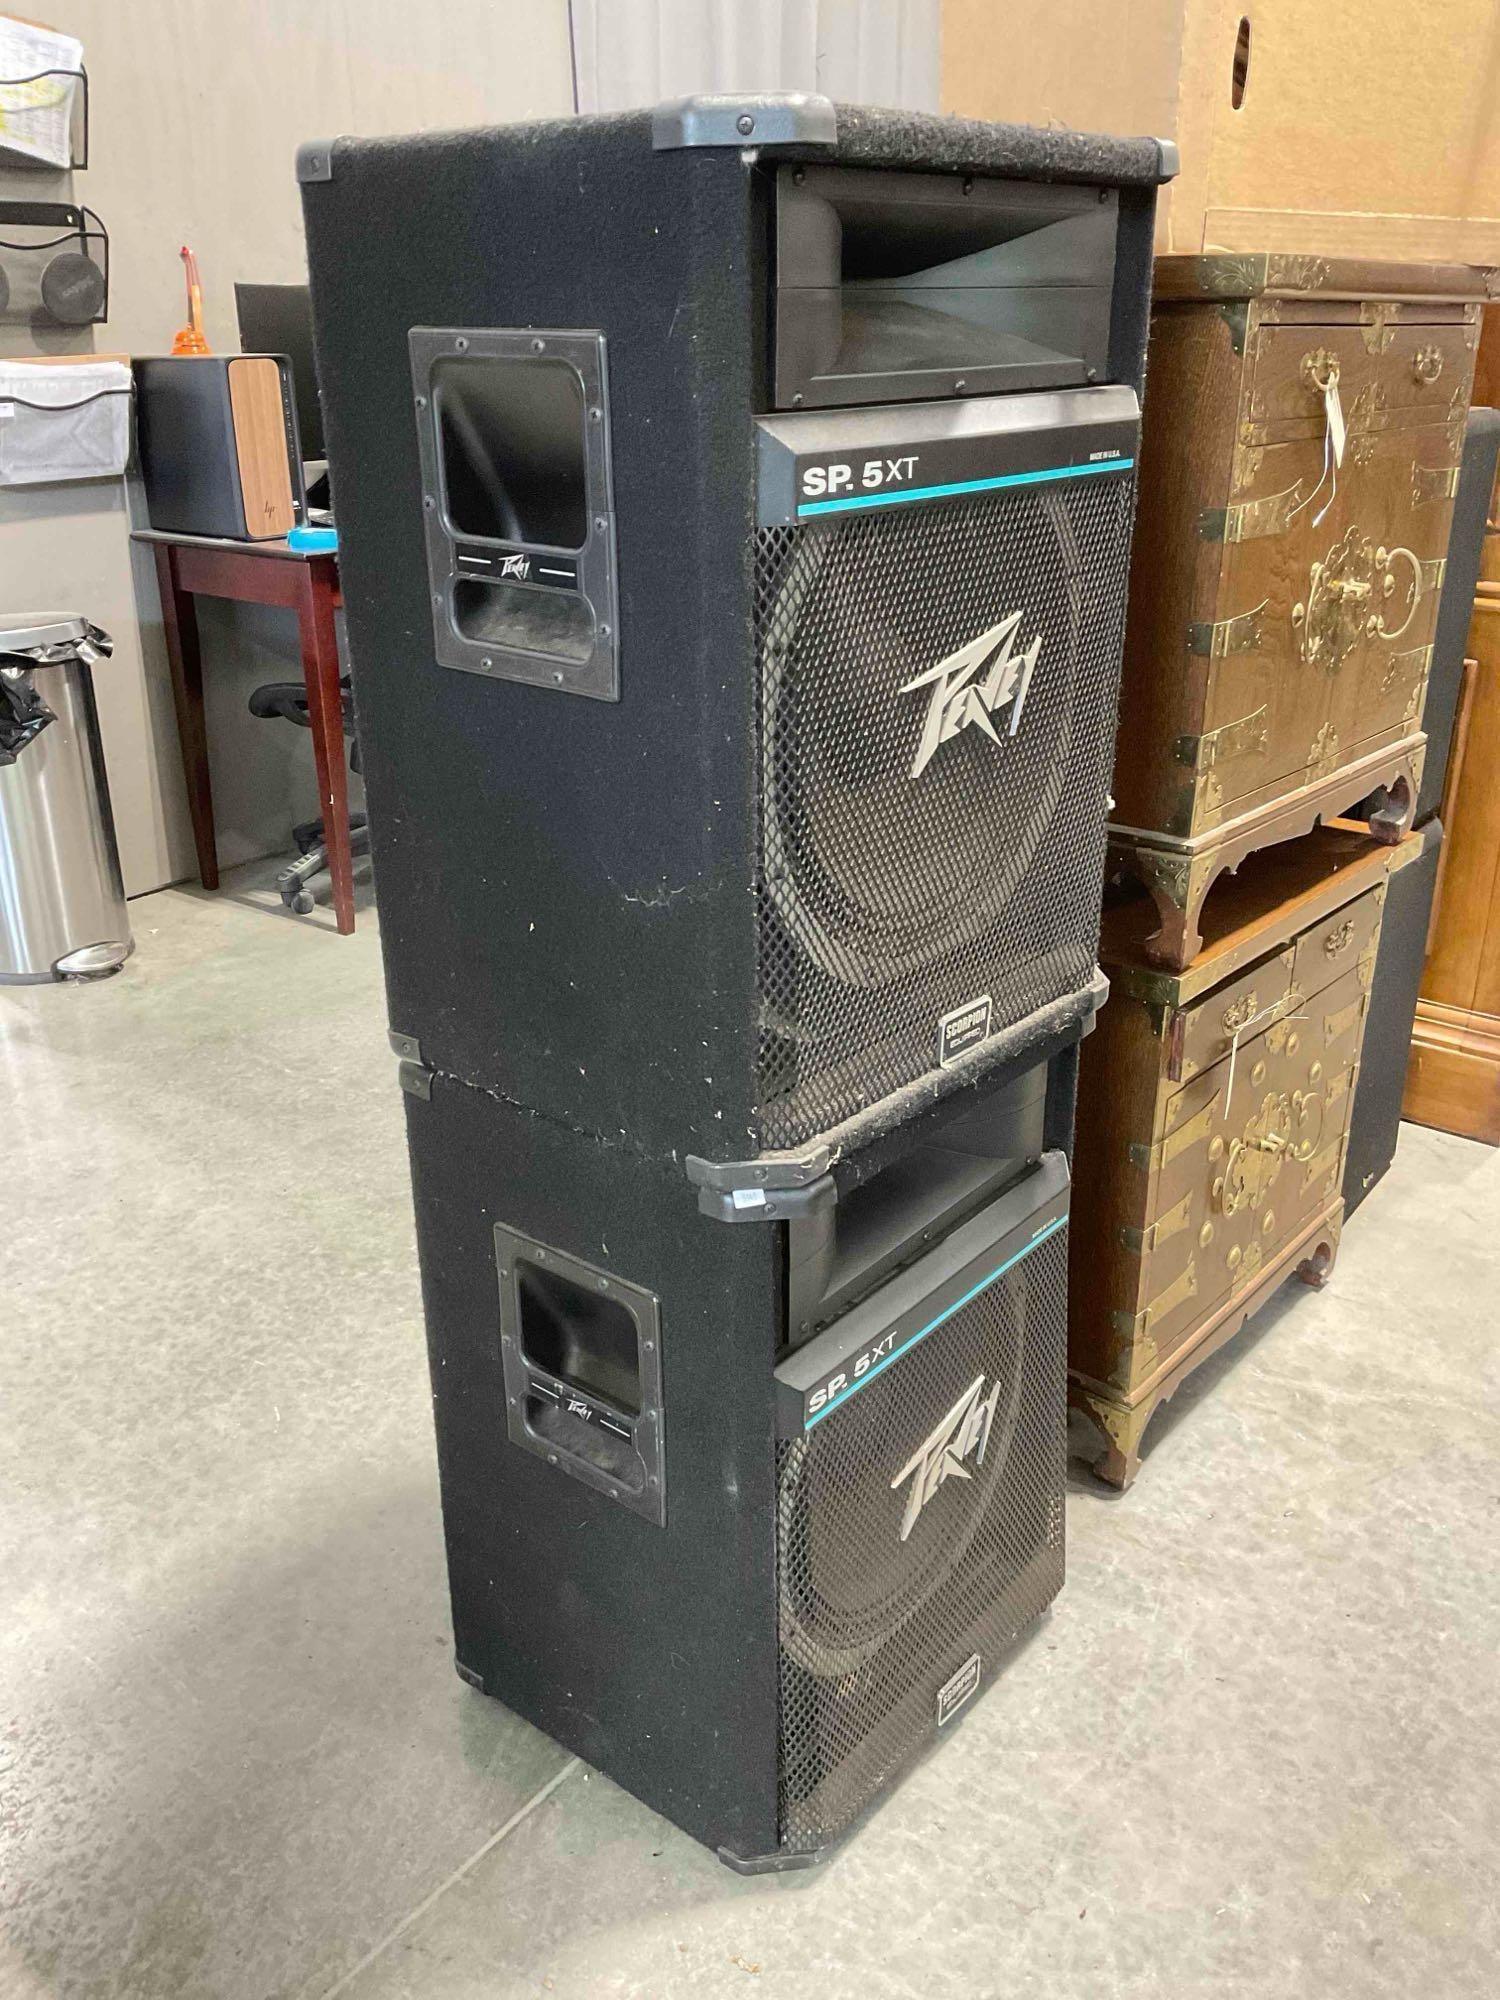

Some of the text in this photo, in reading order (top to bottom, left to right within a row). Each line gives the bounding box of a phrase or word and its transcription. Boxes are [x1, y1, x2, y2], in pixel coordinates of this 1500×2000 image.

[802, 456, 920, 496] SP. 5XT
[808, 1330, 898, 1414] SP. 5XT
